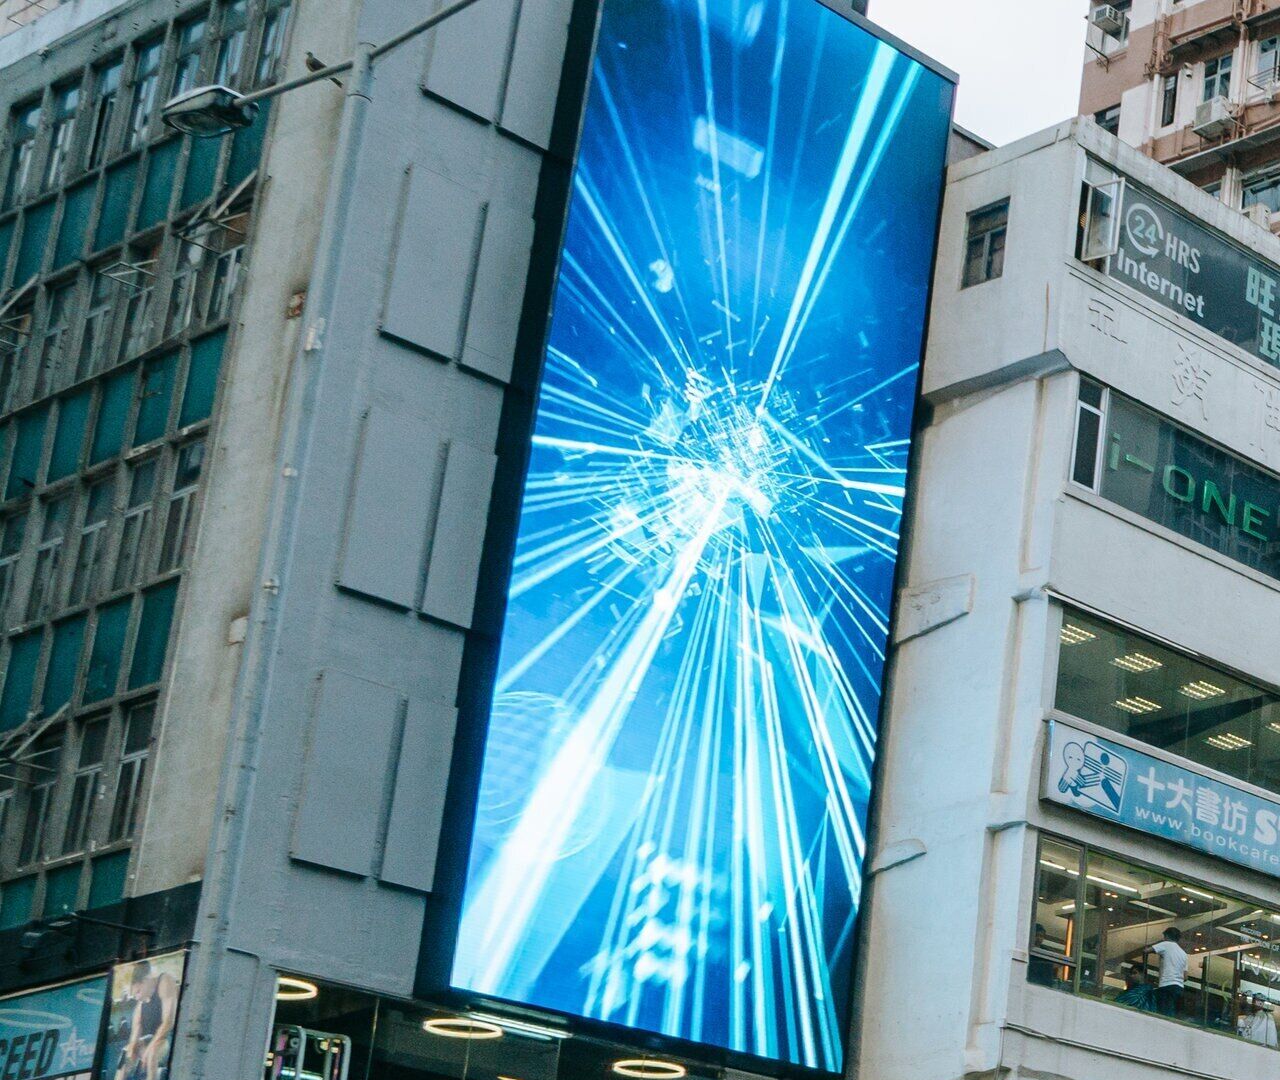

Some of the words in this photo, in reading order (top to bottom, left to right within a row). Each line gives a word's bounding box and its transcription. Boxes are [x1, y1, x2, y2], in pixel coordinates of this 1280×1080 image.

[1133, 215, 1157, 245] 24
[1165, 232, 1201, 274] HRS
[1117, 247, 1205, 318] Internet
[1137, 766, 1248, 836] 十大書坊
